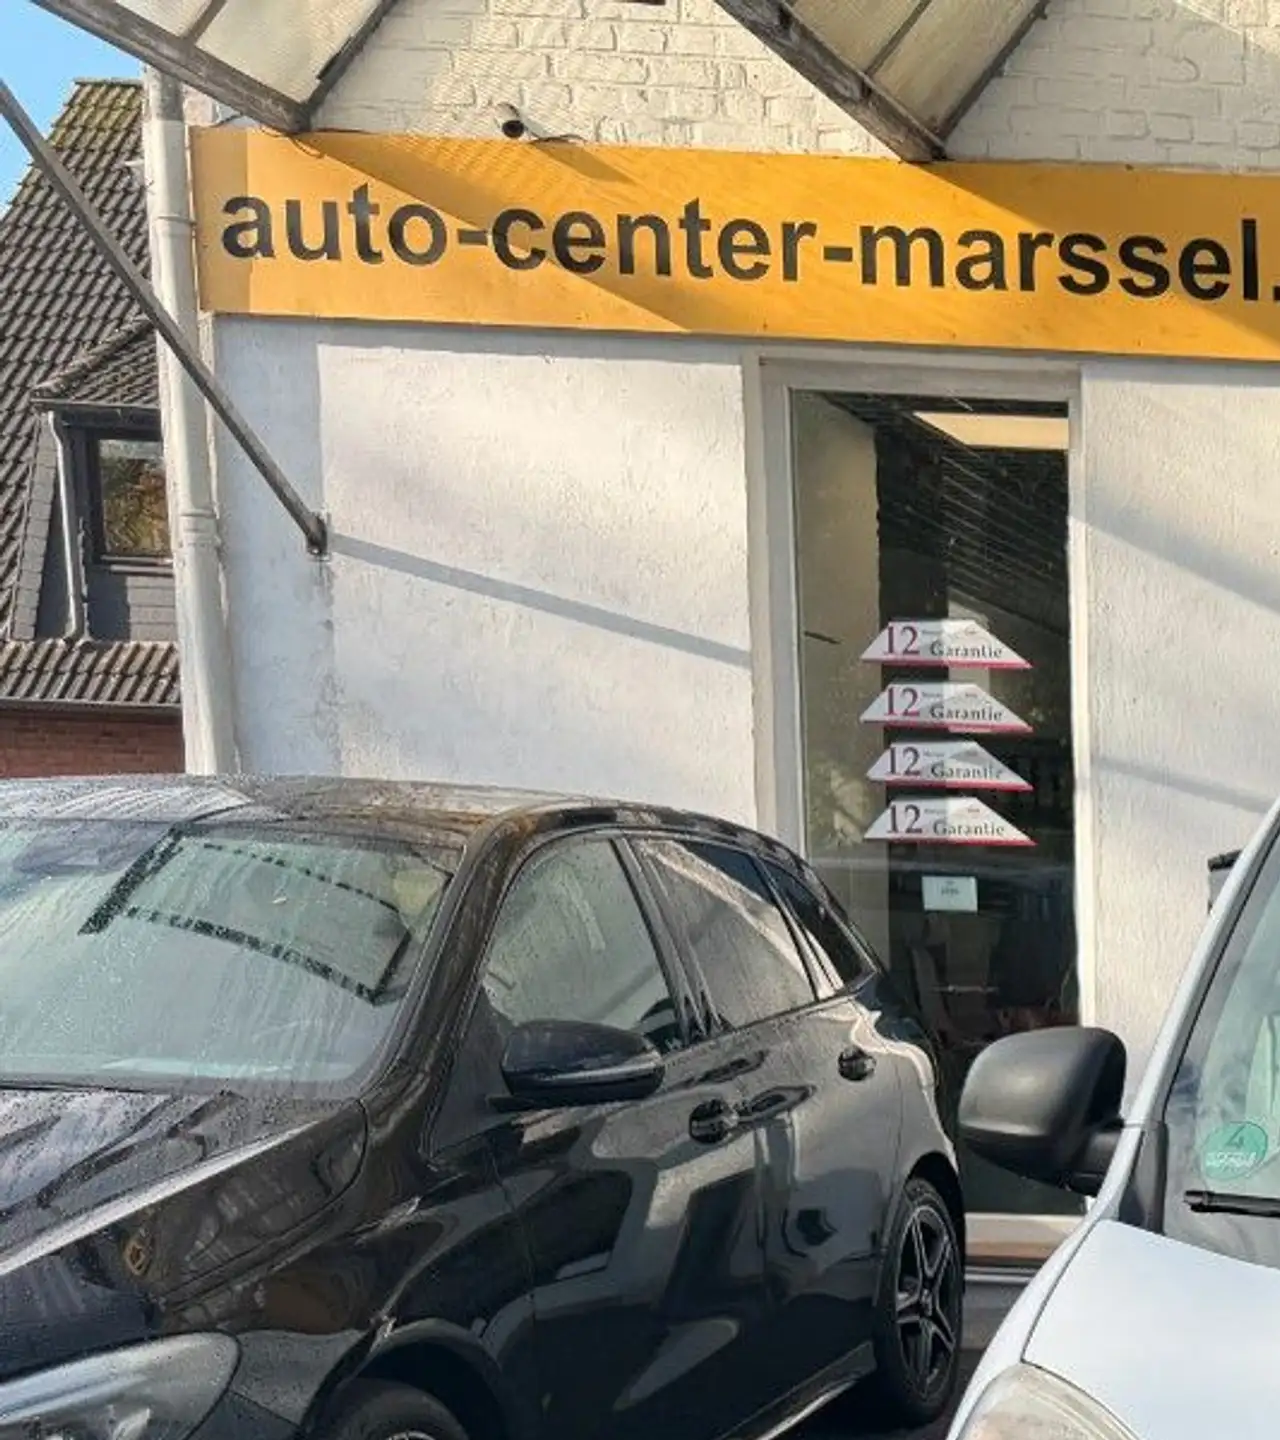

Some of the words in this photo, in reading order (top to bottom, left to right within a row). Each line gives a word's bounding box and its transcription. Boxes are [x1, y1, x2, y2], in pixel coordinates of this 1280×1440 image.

[883, 626, 921, 656] 12
[929, 639, 1003, 659] Garantie
[884, 687, 921, 717] 12
[929, 701, 1003, 721] Garantie
[887, 747, 922, 777] 12
[930, 760, 1004, 780] Garantie
[887, 805, 923, 835] 12
[932, 818, 1005, 836] Garantie
